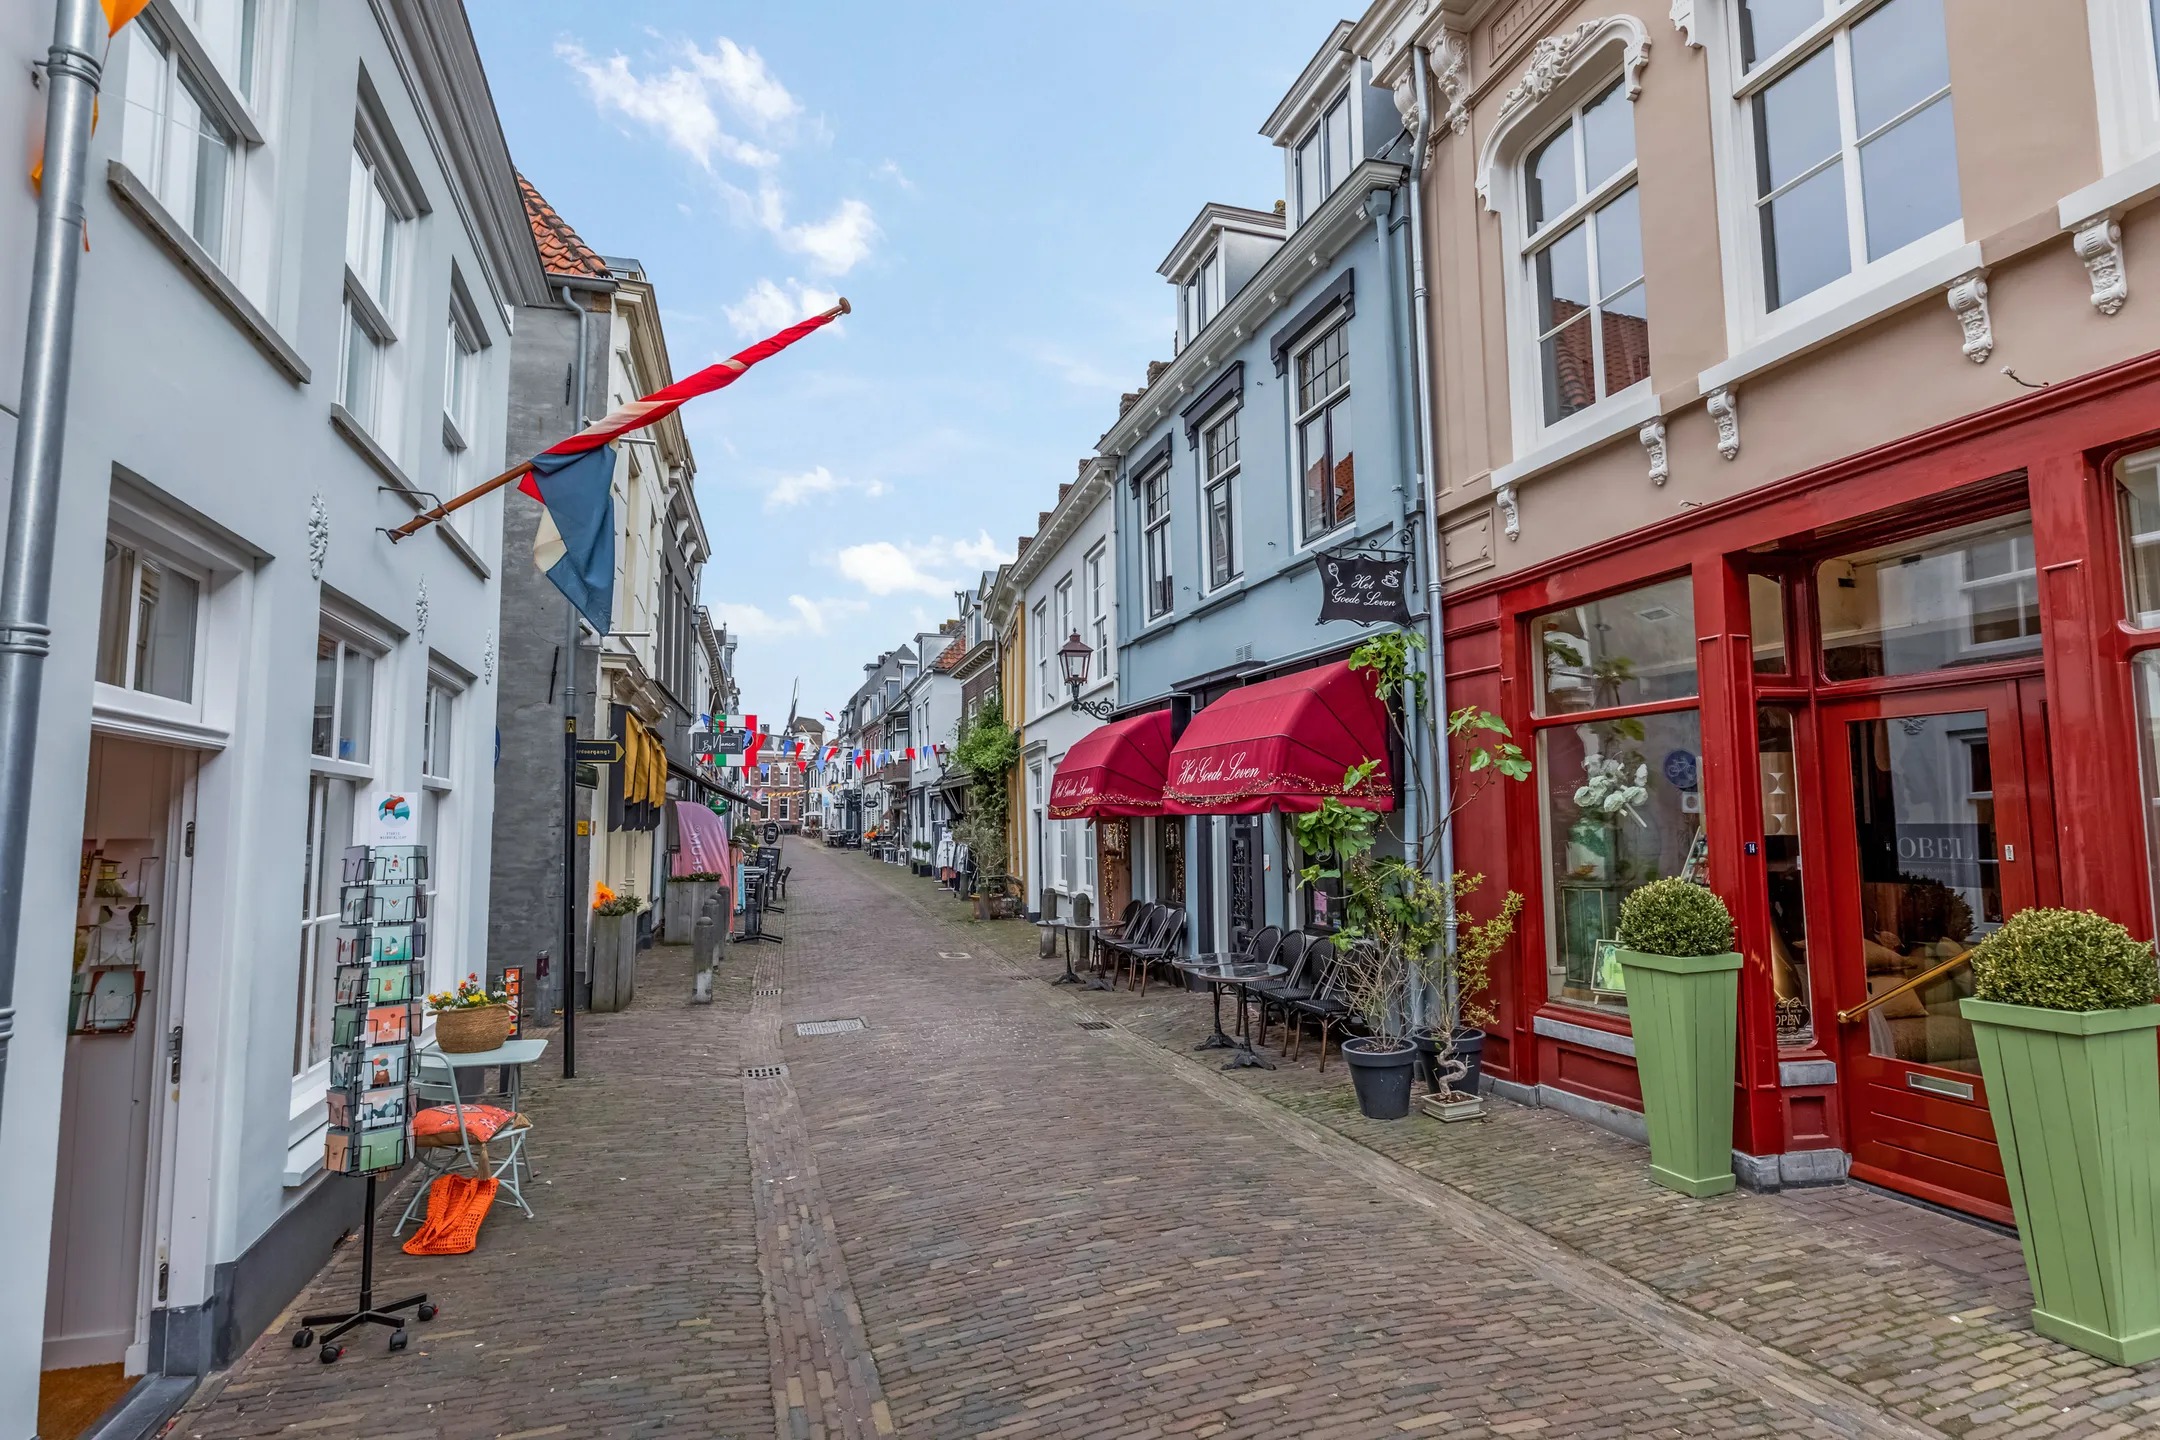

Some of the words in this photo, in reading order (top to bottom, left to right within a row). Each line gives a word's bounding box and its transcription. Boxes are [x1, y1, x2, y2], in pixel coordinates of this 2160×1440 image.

[1351, 574, 1375, 589] Het
[1331, 588, 1360, 603] Goede
[1363, 591, 1396, 606] Leven
[1177, 759, 1198, 785] Het
[1197, 756, 1224, 783] Goede
[1223, 752, 1260, 781] Leven
[1749, 843, 1756, 853] 14
[1898, 836, 1974, 860] OBEL
